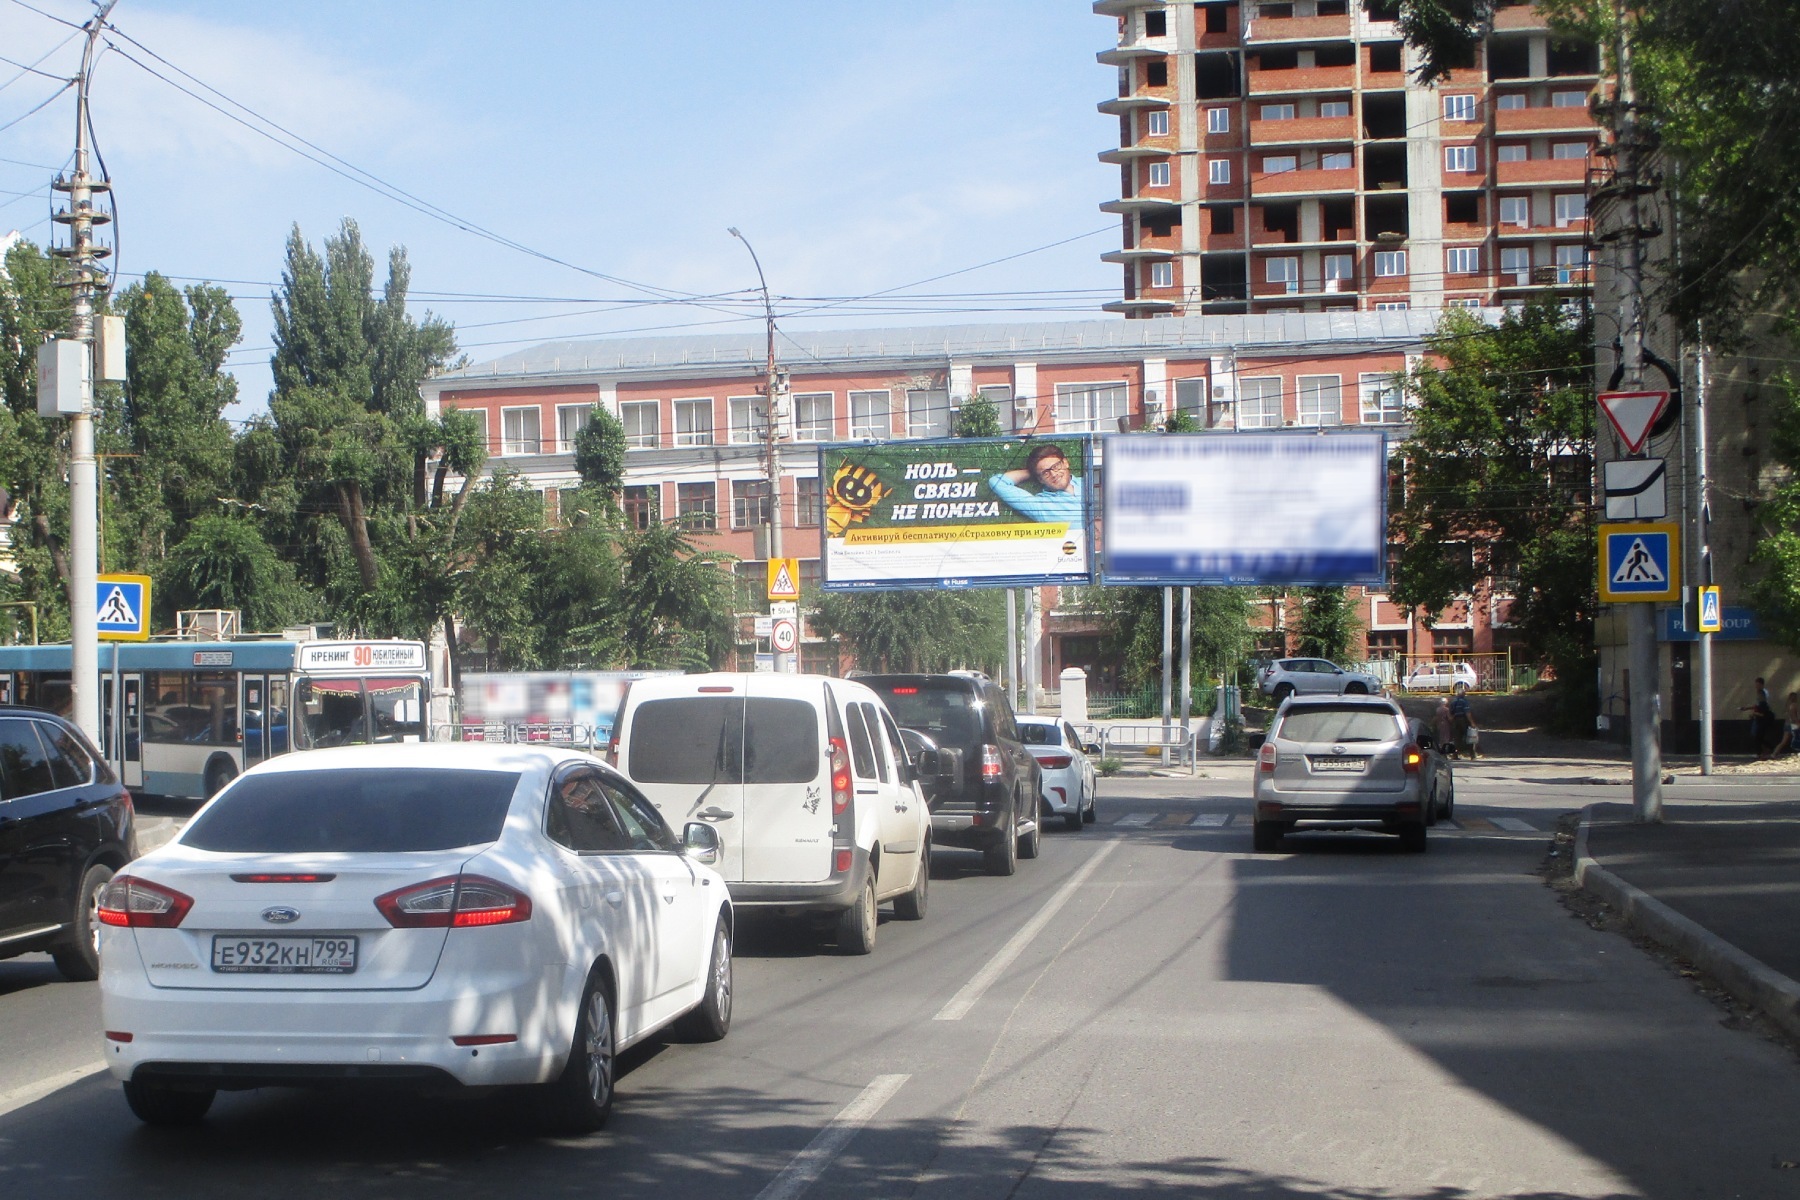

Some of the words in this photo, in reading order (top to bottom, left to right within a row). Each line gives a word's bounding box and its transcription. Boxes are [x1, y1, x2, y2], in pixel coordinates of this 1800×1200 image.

[905, 463, 958, 479] НОЛЬ
[914, 482, 978, 499] СВЯЗИ
[891, 504, 918, 520] НЕ
[921, 501, 999, 519] ПОМЕХА
[851, 532, 900, 542] Активируй
[902, 531, 957, 541] бесплатную
[960, 529, 1012, 539] «Страховку
[1014, 530, 1035, 538] при
[1035, 528, 1062, 537] нуле»
[779, 631, 791, 642] 40
[311, 650, 350, 662] КРЕКИНГ
[354, 646, 371, 666] 90
[373, 647, 414, 660] ЮБИЛЕЙНЫЙ
[268, 910, 289, 920] Ford
[221, 941, 309, 965] Е932КН
[314, 940, 349, 959] 799
